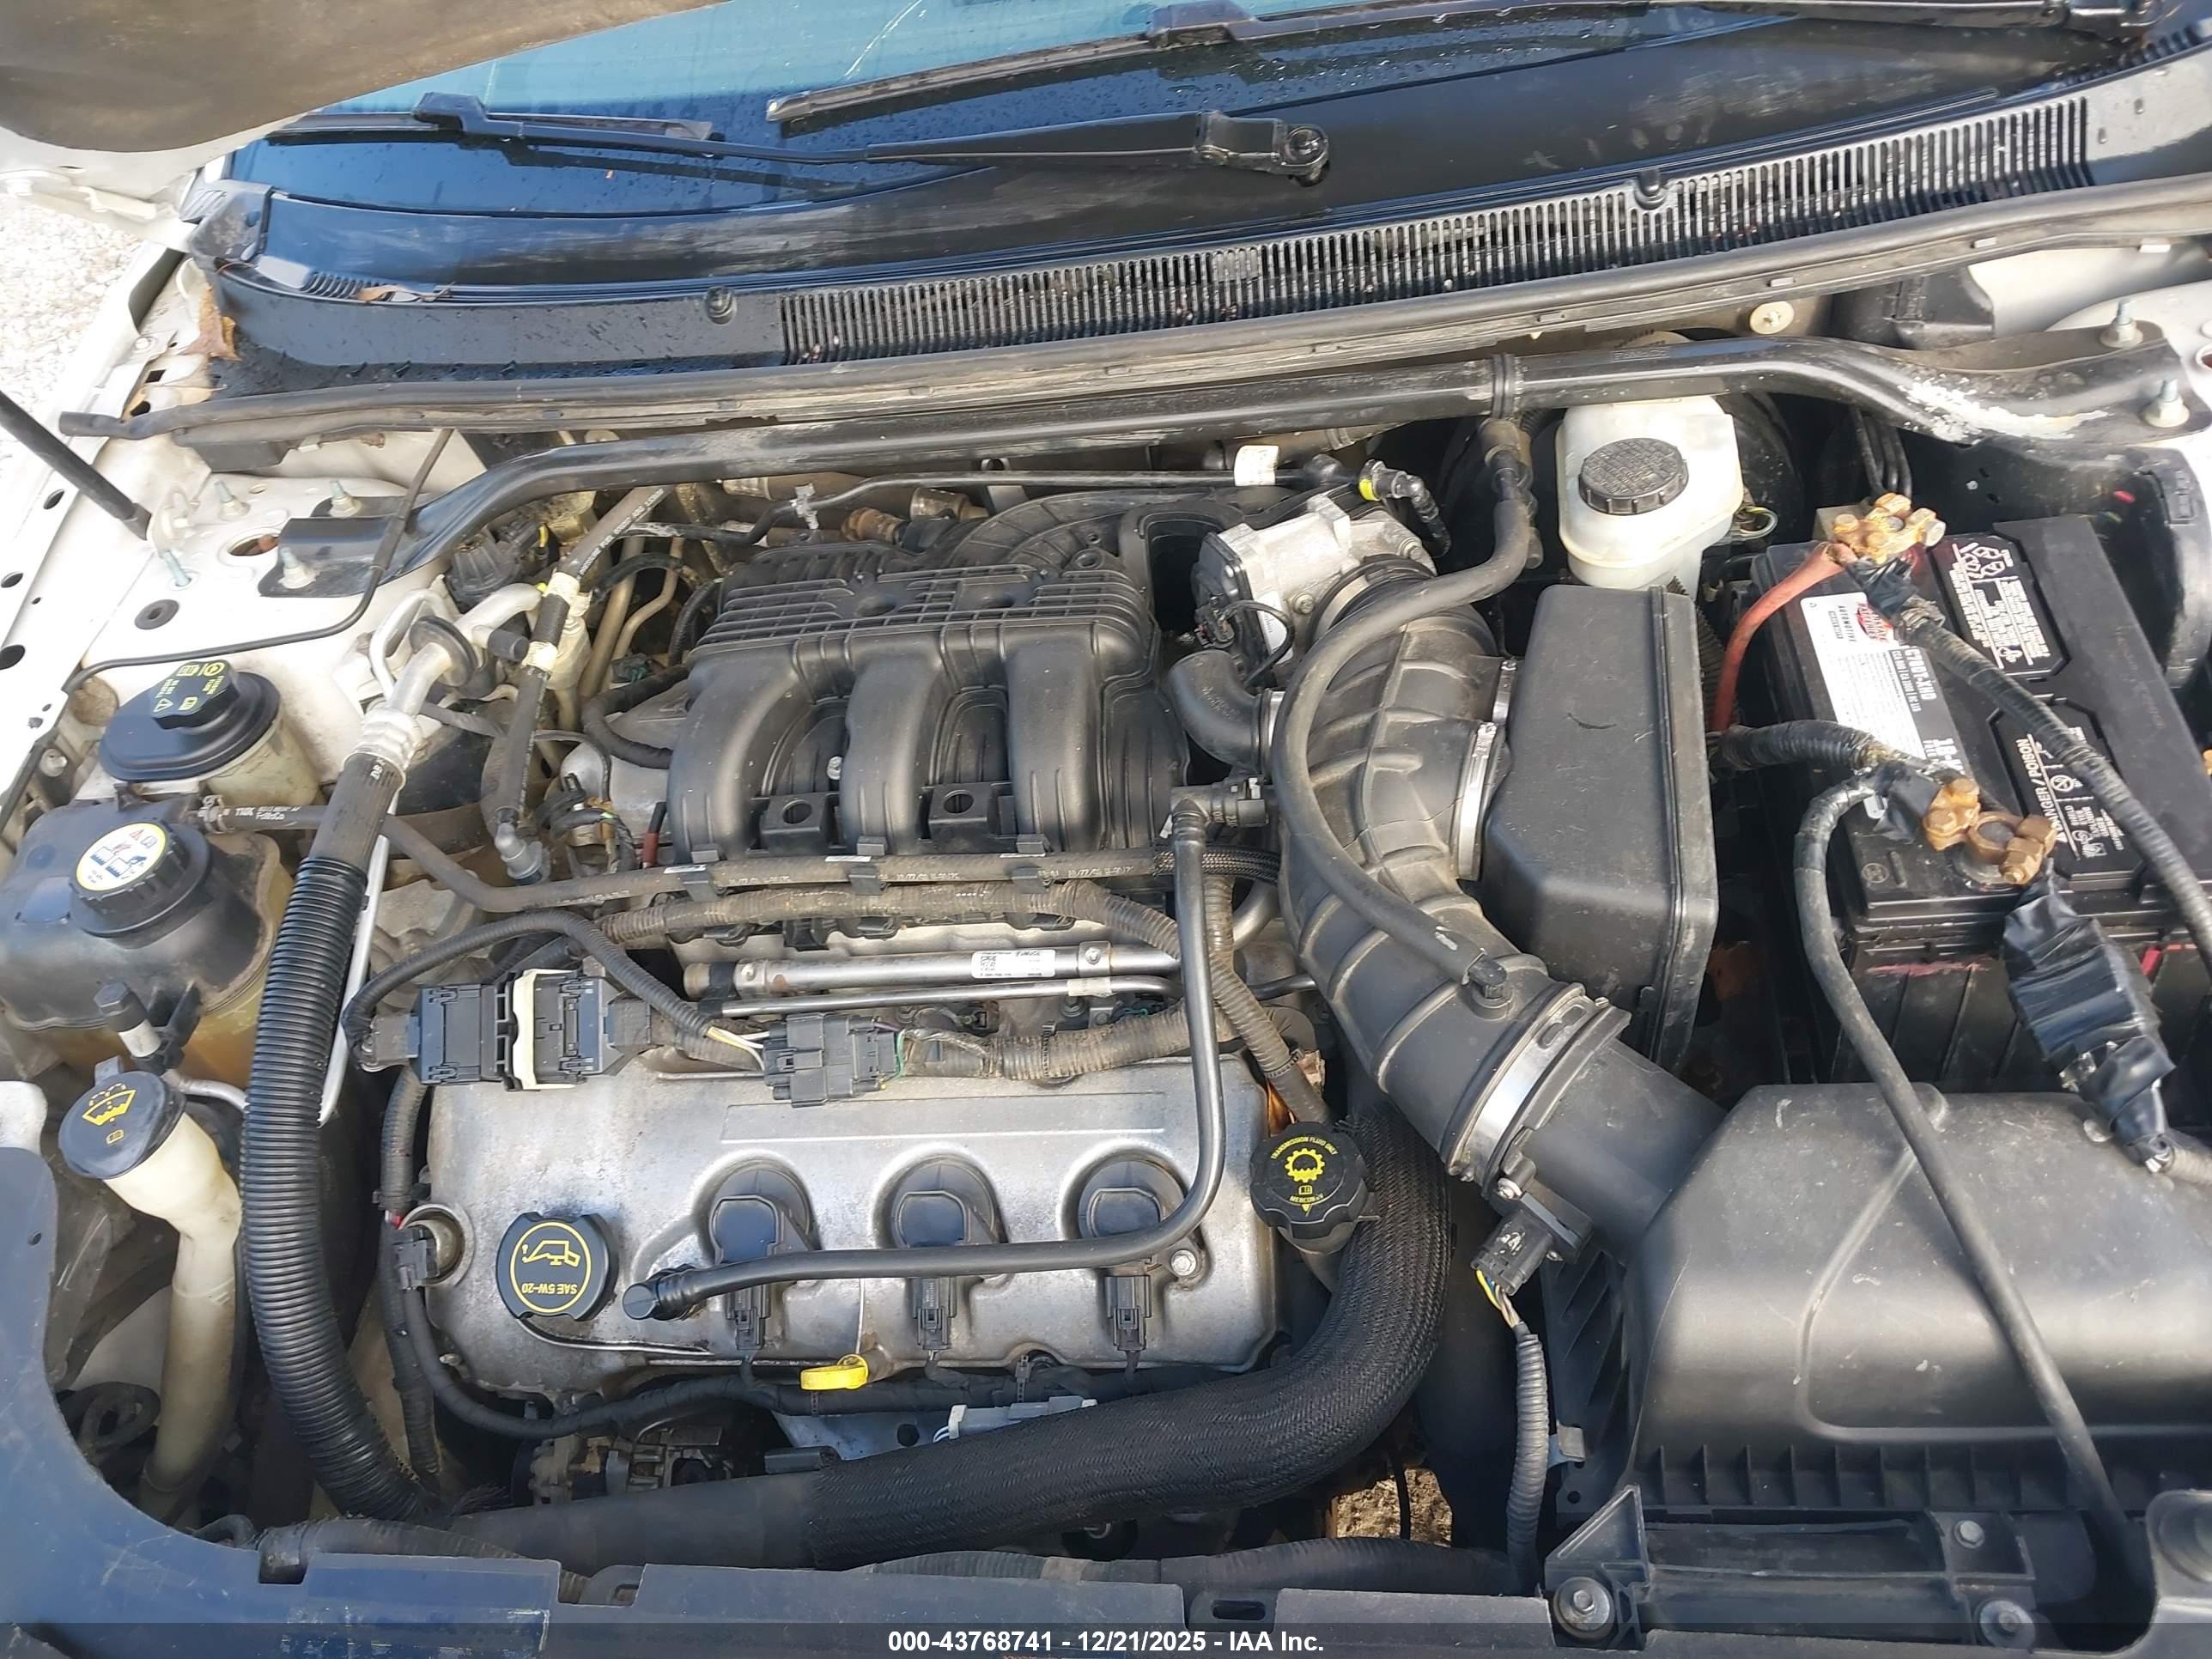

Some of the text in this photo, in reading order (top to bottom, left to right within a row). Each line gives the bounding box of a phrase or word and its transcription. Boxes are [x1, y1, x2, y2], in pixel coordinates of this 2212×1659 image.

[1309, 1136, 1327, 1146] FLUID
[1324, 1143, 1340, 1155] ONLY
[521, 1282, 578, 1295] SAE 5W-20
